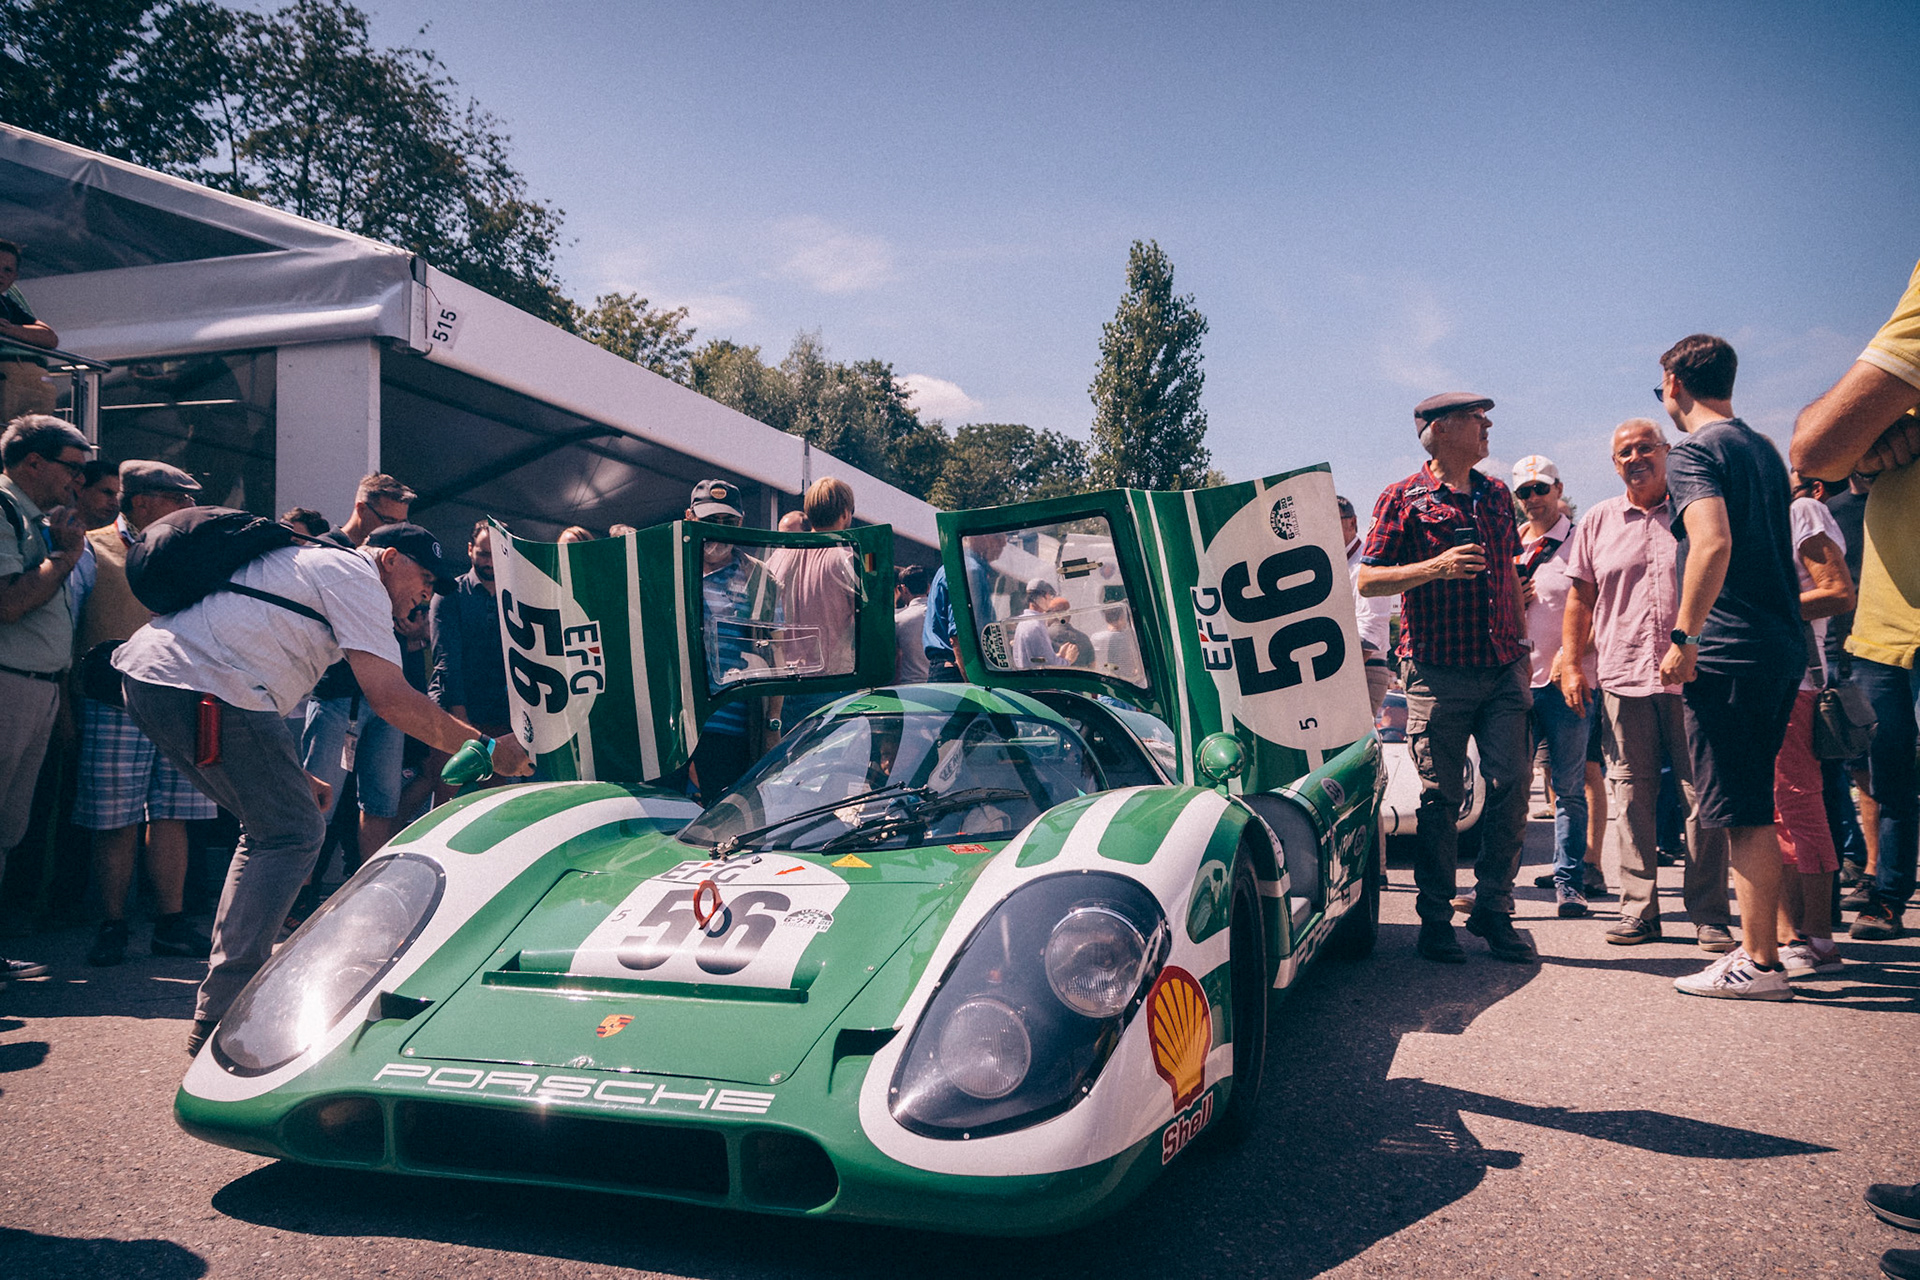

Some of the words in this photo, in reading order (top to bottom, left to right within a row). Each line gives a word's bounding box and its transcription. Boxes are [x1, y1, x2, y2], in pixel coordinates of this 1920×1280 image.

[432, 309, 457, 342] 515
[502, 588, 569, 714] 56
[1192, 587, 1233, 671] EFG
[1221, 544, 1346, 696] 56
[563, 623, 604, 696] EFG
[1299, 717, 1318, 731] 5
[660, 861, 751, 883] EFG
[611, 909, 633, 923] 5
[617, 890, 791, 976] 56
[373, 1063, 776, 1114] PORSCHE
[1162, 1091, 1213, 1164] Shell
